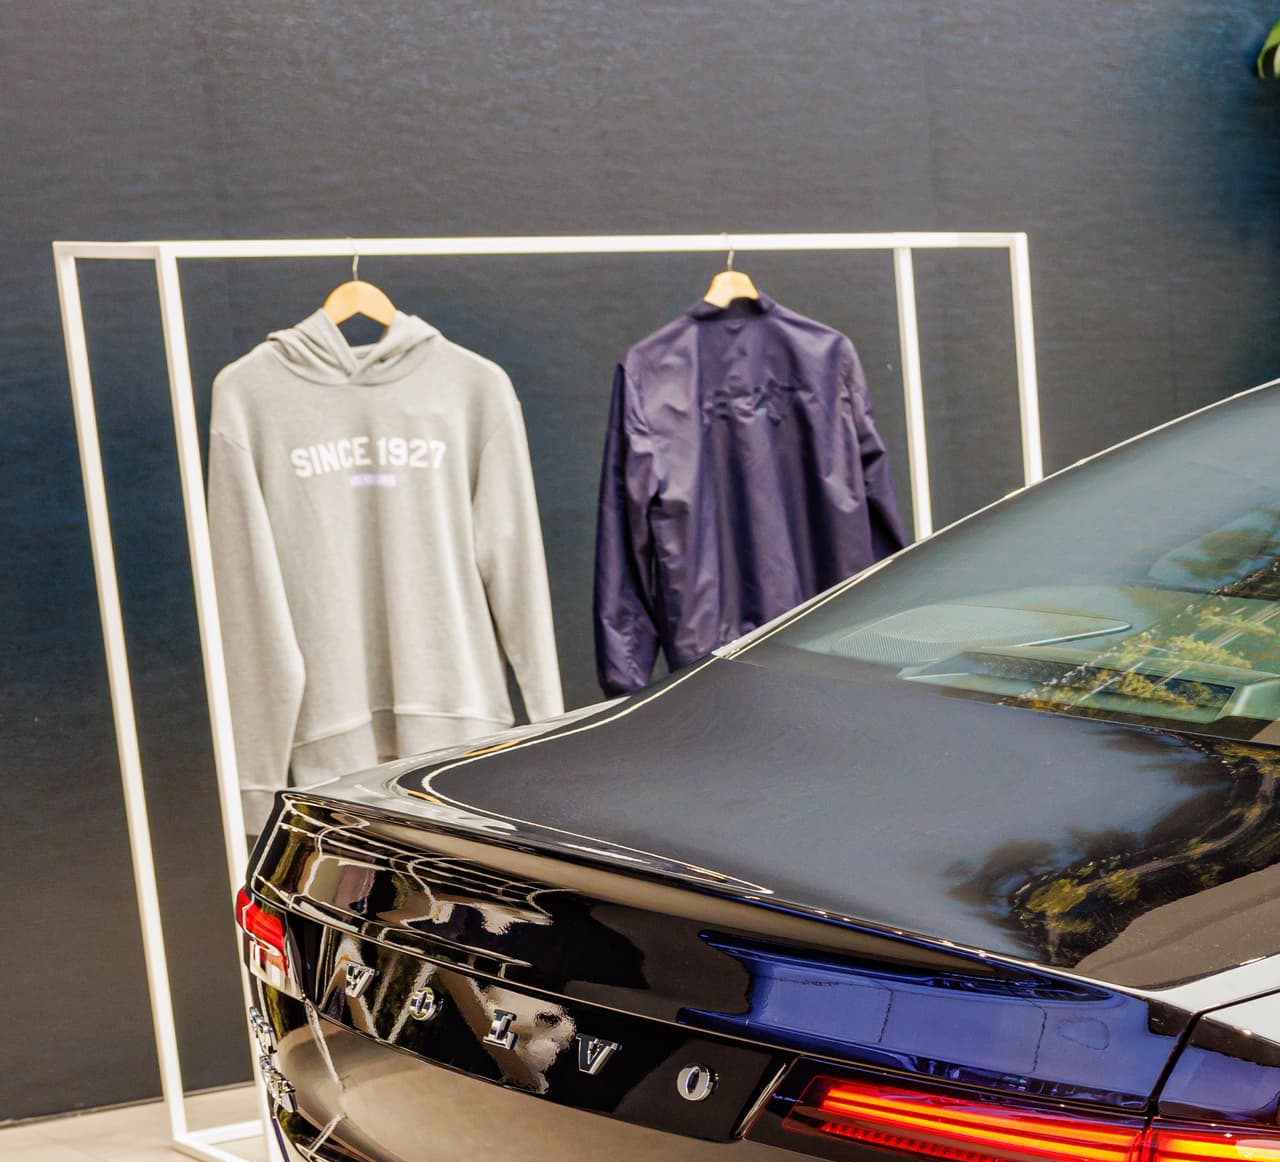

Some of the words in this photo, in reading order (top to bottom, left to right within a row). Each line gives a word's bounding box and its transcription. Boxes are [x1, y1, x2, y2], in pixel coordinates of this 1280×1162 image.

[290, 436, 372, 478] SINCE
[376, 437, 447, 469] 1927
[345, 963, 717, 1102] VOLVO
